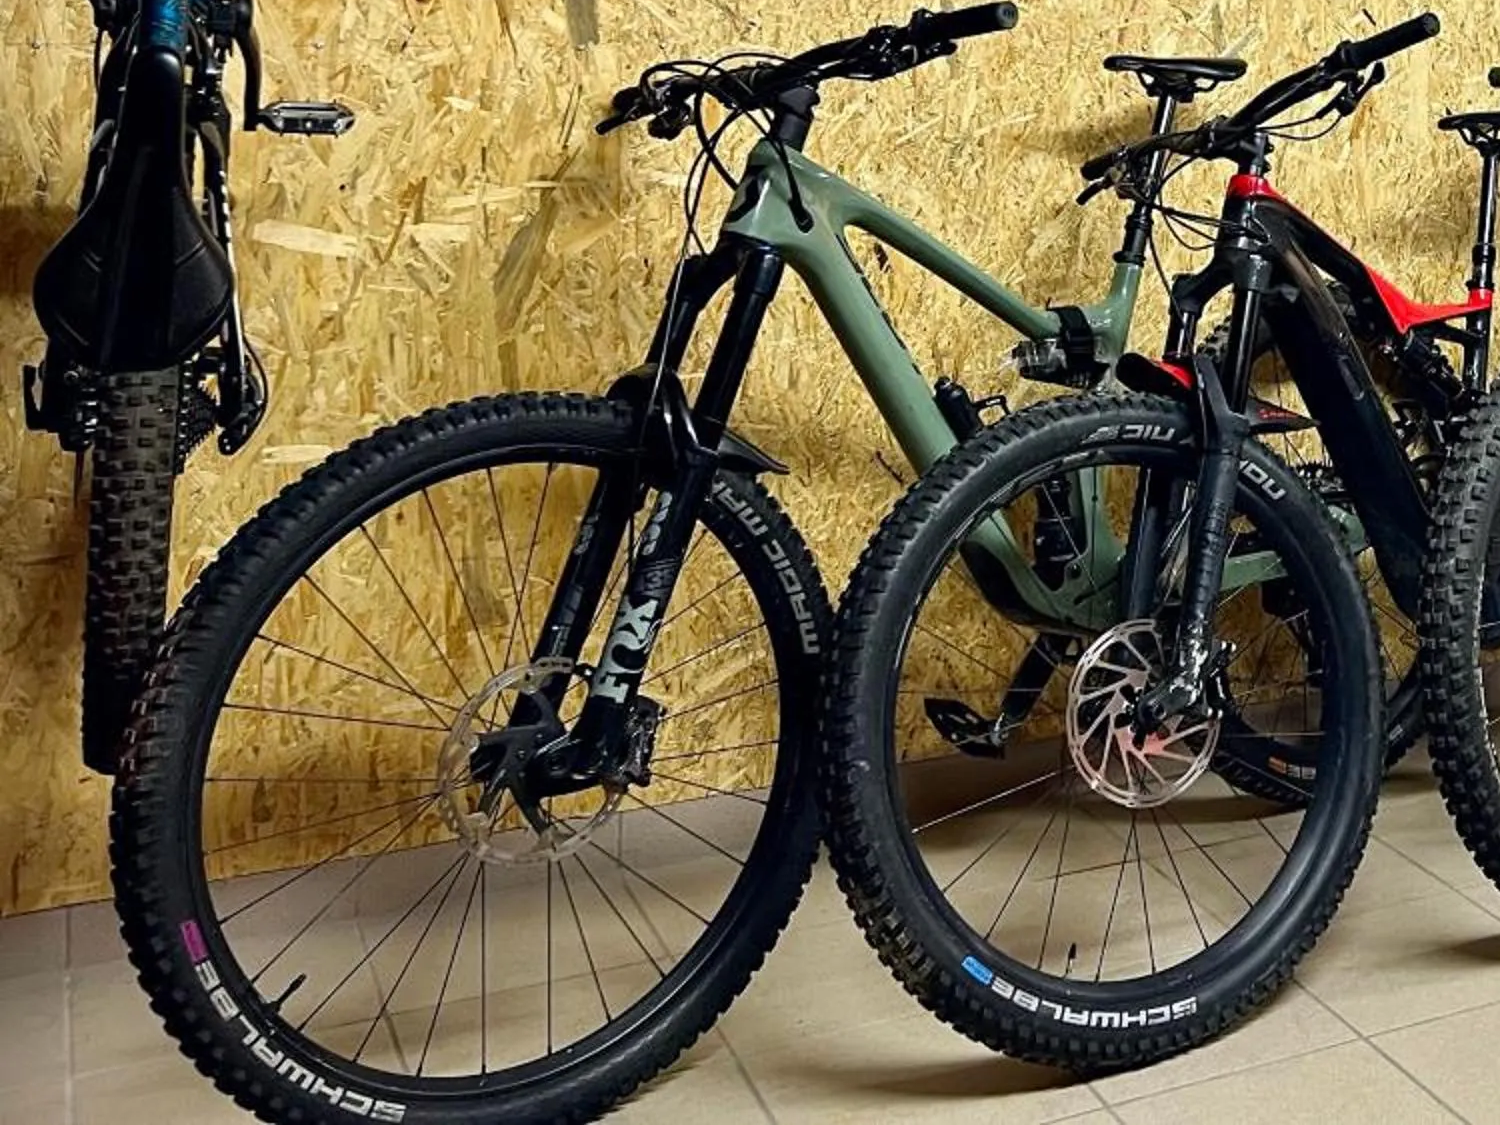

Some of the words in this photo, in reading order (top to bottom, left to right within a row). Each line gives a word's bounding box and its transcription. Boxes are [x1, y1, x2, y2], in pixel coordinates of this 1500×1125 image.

[1121, 424, 1176, 441] NIC
[590, 595, 664, 704] FOX
[762, 538, 821, 655] MAGIC
[195, 960, 407, 1124] SCHWALBE
[991, 976, 1197, 1028] SCHWALBE
